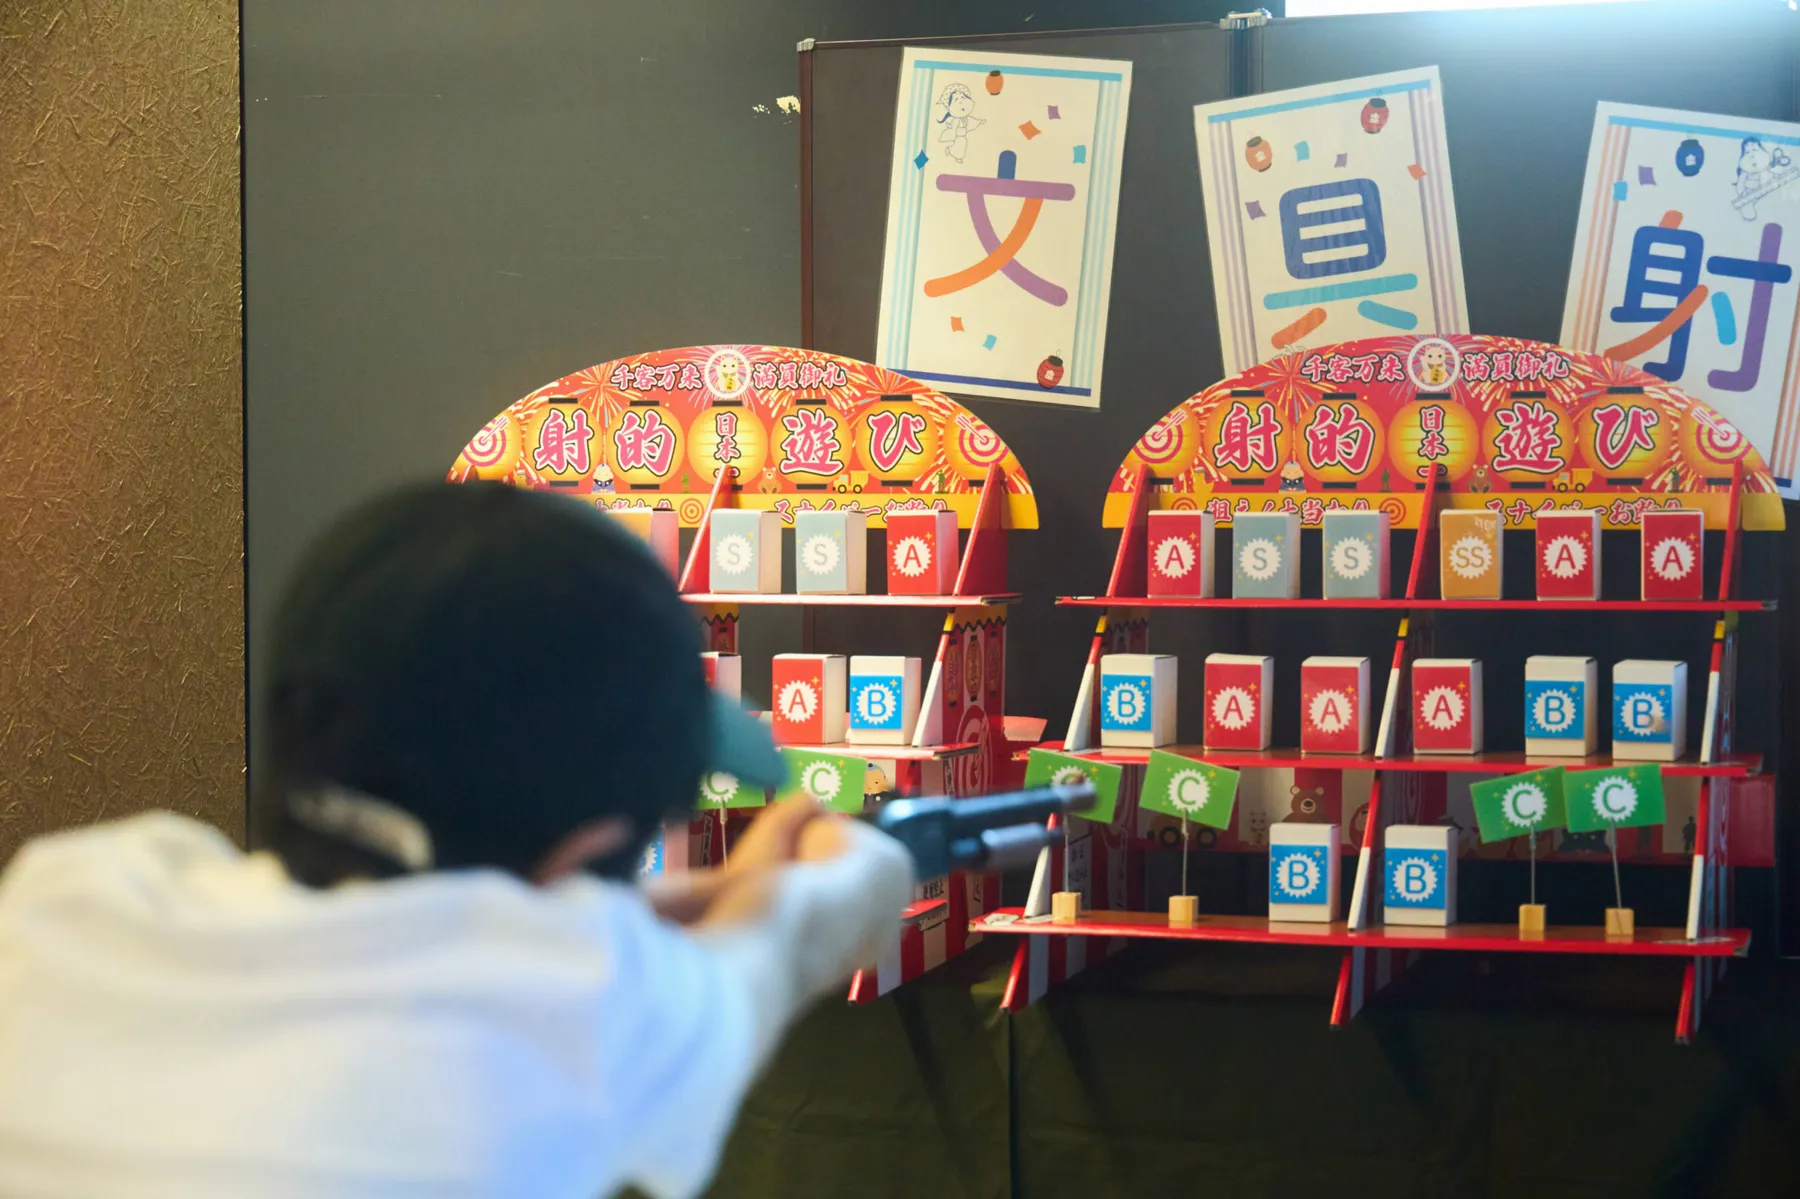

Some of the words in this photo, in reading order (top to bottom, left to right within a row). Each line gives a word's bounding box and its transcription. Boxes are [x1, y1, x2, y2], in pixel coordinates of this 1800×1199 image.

[924, 150, 1075, 306] 文
[1263, 178, 1418, 349] 具
[1604, 210, 1792, 392] 射
[611, 363, 703, 391] 千客万来
[753, 361, 847, 390] 満員御礼
[1302, 352, 1405, 382] 千客万来
[1462, 351, 1570, 382] 満員御礼
[726, 543, 741, 566] S
[813, 544, 829, 566] S
[902, 544, 922, 568] A
[1164, 544, 1185, 570] A
[1252, 547, 1268, 571] S
[1343, 546, 1359, 570] S
[1455, 546, 1486, 569] SS
[1553, 543, 1576, 570] A
[1661, 545, 1684, 572] A
[788, 688, 807, 714] A
[867, 689, 885, 716] B
[1117, 689, 1136, 718] B
[1222, 695, 1244, 721] A
[1320, 697, 1342, 725] A
[1431, 694, 1454, 721] A
[1544, 696, 1566, 725] B
[1632, 699, 1654, 729] B
[810, 767, 832, 797] C
[1176, 776, 1201, 805] C
[1511, 788, 1538, 820] C
[1601, 783, 1625, 815] C
[1287, 859, 1310, 891] B
[1404, 863, 1427, 895] B
